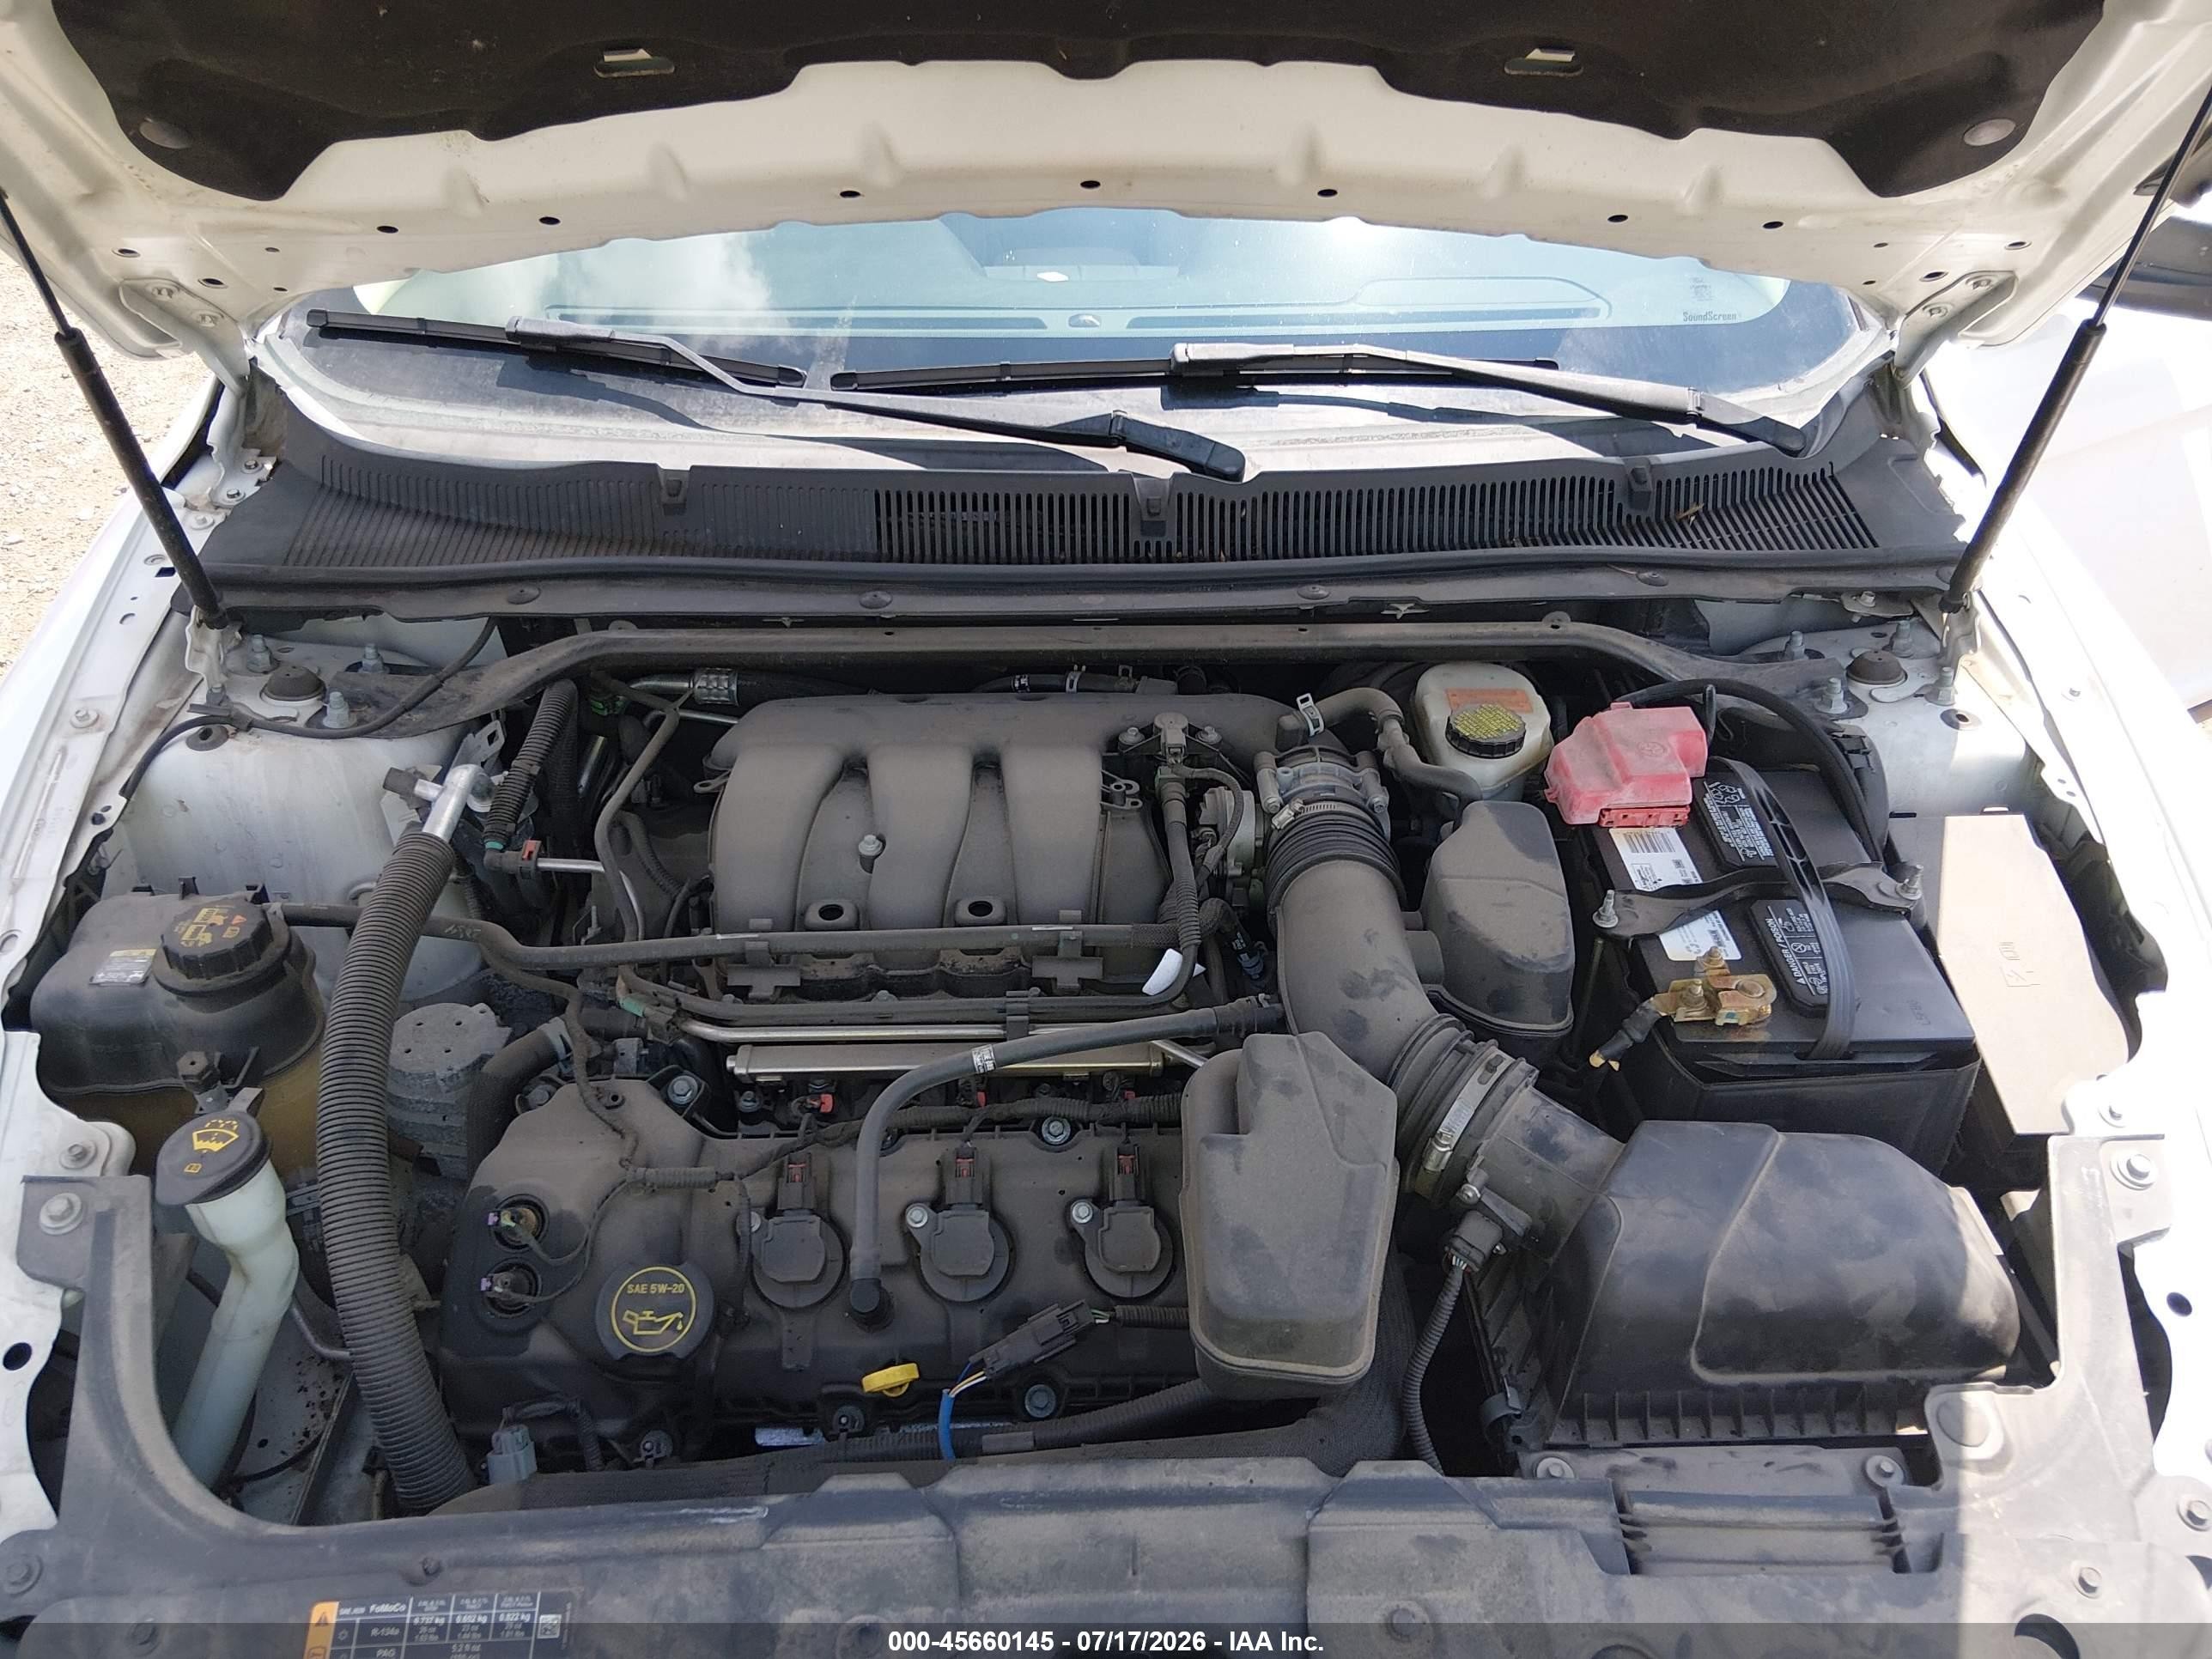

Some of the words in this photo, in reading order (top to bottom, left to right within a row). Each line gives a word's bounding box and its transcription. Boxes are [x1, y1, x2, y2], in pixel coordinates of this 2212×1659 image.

[1683, 310, 1737, 323] SoundScreen
[1765, 918, 1785, 943] POISON
[1782, 949, 1802, 977] DANGER
[627, 1283, 647, 1294] SAE
[649, 1283, 685, 1294] 5W-20
[369, 1602, 406, 1613] FoMoCo
